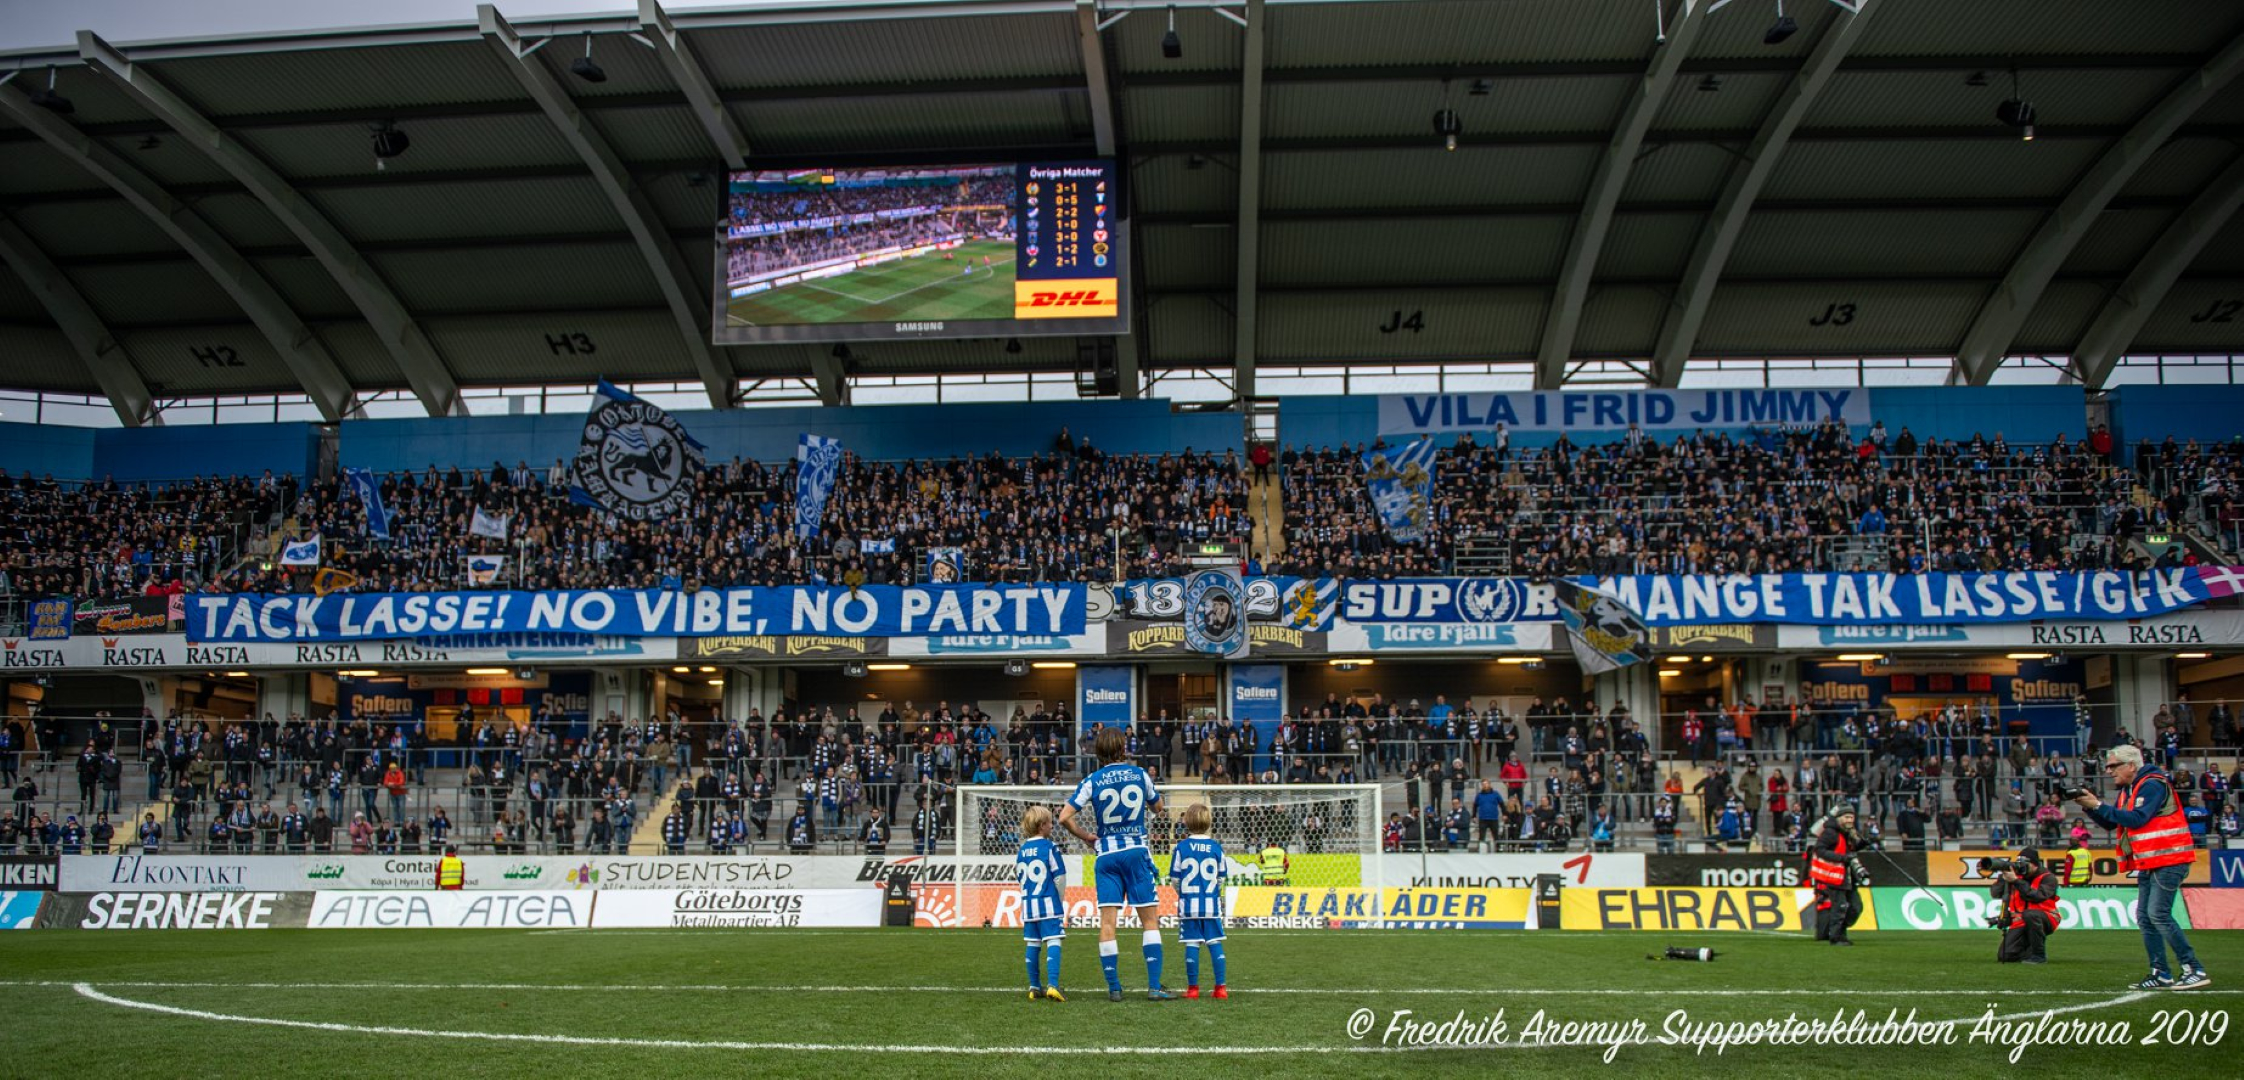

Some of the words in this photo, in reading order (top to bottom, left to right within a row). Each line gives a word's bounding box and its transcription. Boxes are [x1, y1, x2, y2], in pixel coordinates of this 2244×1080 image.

[1030, 167, 1061, 180] Övriga
[1063, 167, 1103, 178] Matcher
[1030, 290, 1103, 306] DHL
[1379, 311, 1425, 333] J4
[1809, 303, 1857, 326] J3
[895, 322, 944, 332] SAMSUNG
[545, 332, 597, 356] H3
[190, 345, 246, 367] H2
[1405, 396, 1529, 427] VILA
[1535, 395, 1545, 425] I
[1565, 393, 1675, 424] FRID
[1691, 389, 1851, 423] JIMMY
[1346, 583, 1451, 617] SUP
[1603, 573, 1787, 620] MANGE
[1802, 573, 1902, 619] TAK
[199, 596, 322, 638] TACK
[340, 594, 511, 636] LASSE!
[527, 591, 616, 630] NO
[635, 588, 768, 635] VIBE,
[792, 588, 879, 633] NO
[900, 587, 1072, 633] PARTY
[1128, 625, 1185, 650] KOPPARB
[1249, 625, 1303, 648] PARBERG
[1383, 624, 1436, 642] Idre
[2032, 625, 2106, 644] RASTA
[2129, 624, 2203, 643] RASTA
[4, 649, 65, 667] RASTA
[103, 648, 166, 666] RASTA
[186, 647, 250, 664] RASTA
[296, 646, 361, 662] RASTA
[2011, 677, 2080, 702] Sofiero
[1095, 773, 1141, 786] WELLNESS
[1098, 784, 1143, 824] 29
[1189, 842, 1212, 853] VIBE
[606, 858, 793, 882] STUDENTSTÄD
[1017, 859, 1047, 897] 29
[1181, 858, 1218, 894] 29
[1701, 860, 1799, 888] morris
[81, 892, 278, 929] SERNEKE
[675, 890, 804, 914] Göteborgs
[1271, 888, 1488, 918] BLÅKLÄDER
[1597, 890, 1784, 930] EHRAB
[671, 914, 771, 928] Metallpartier
[774, 914, 800, 928] AB
[1248, 915, 1324, 929] SERNEKE
